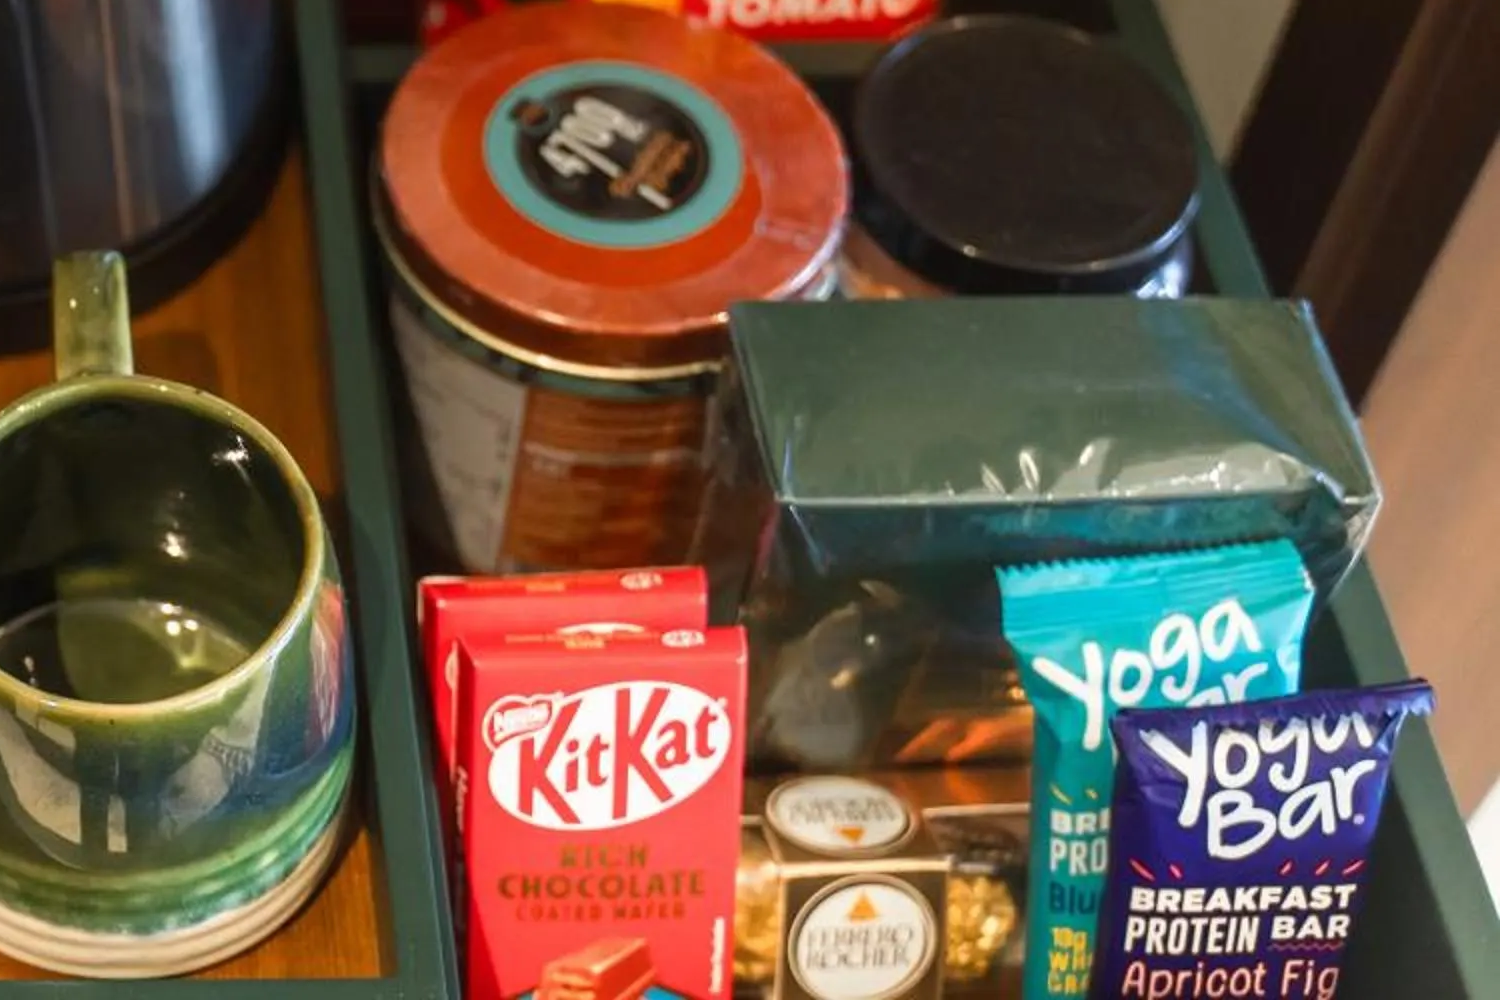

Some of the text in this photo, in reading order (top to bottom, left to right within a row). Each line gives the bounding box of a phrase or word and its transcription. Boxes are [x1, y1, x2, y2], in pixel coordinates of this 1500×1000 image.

[1032, 598, 1265, 751] Yoga
[517, 687, 719, 825] KitKat
[1207, 759, 1378, 860] Bar
[560, 843, 648, 870] RICH
[1049, 837, 1110, 877] PRO
[497, 868, 706, 900] CHOCOLATE
[1049, 881, 1097, 916] Blu
[1129, 882, 1357, 915] BREAKFAST
[1123, 914, 1350, 956] PROTEIN BAR
[1121, 959, 1341, 1000] Apricot Fig
